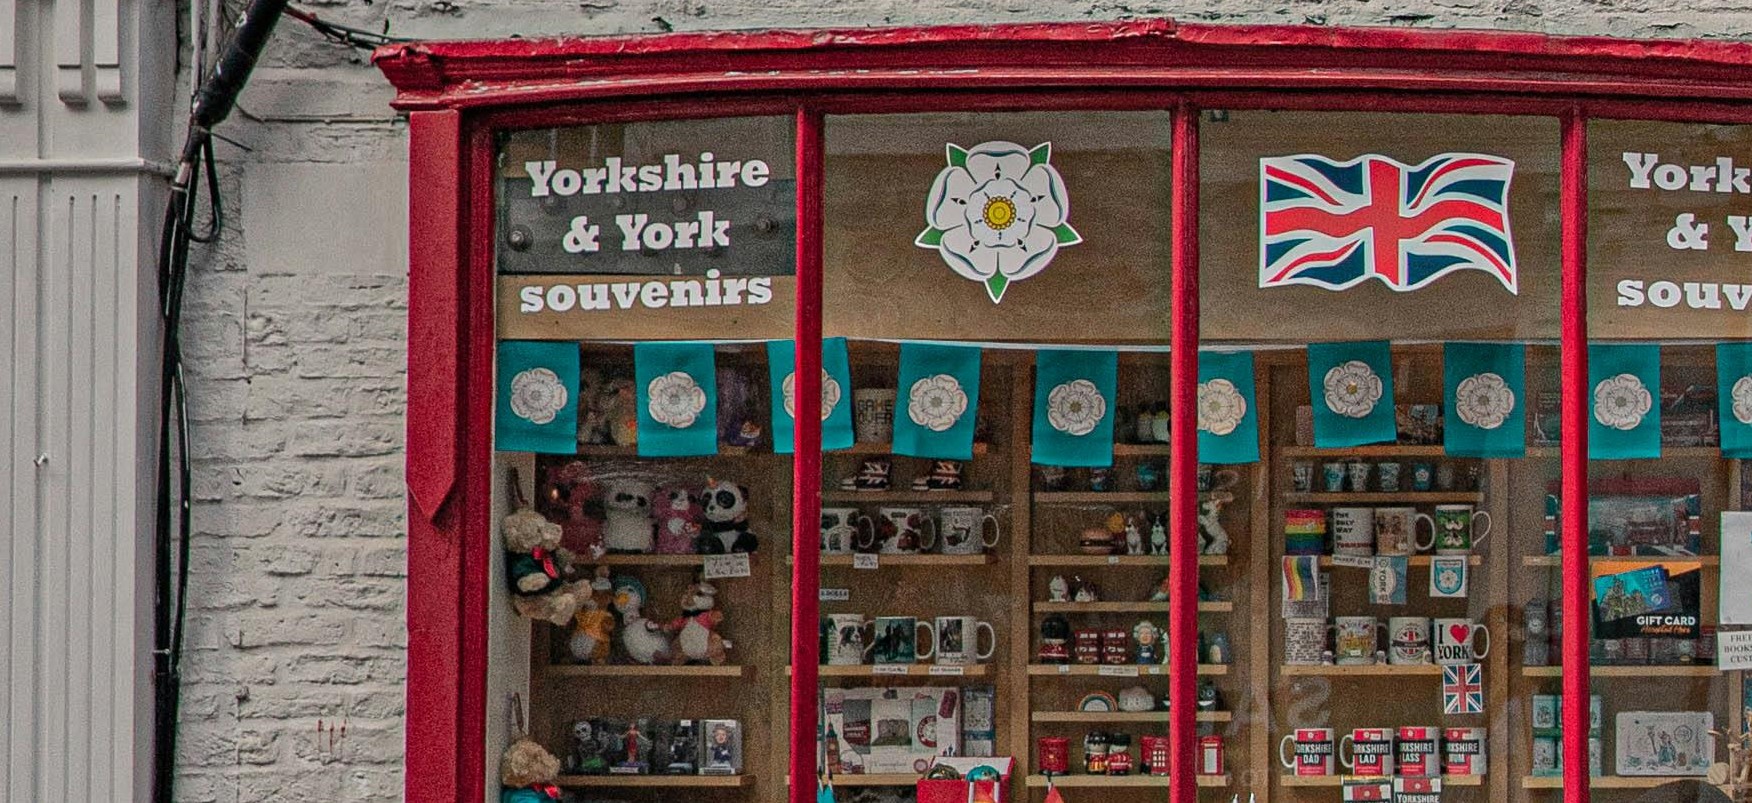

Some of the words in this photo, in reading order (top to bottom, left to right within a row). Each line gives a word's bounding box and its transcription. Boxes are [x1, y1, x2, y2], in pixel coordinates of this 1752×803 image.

[525, 152, 770, 197] Yorkshire
[563, 215, 600, 253] &
[615, 210, 730, 251] York
[1666, 213, 1708, 250] &
[520, 268, 773, 313] souvenirs
[1636, 616, 1662, 626] GIFT
[1664, 616, 1696, 626] CARD
[1439, 624, 1444, 642] I
[1437, 645, 1469, 660] YORK
[1303, 755, 1320, 764] DAD
[1359, 755, 1376, 764] LAD
